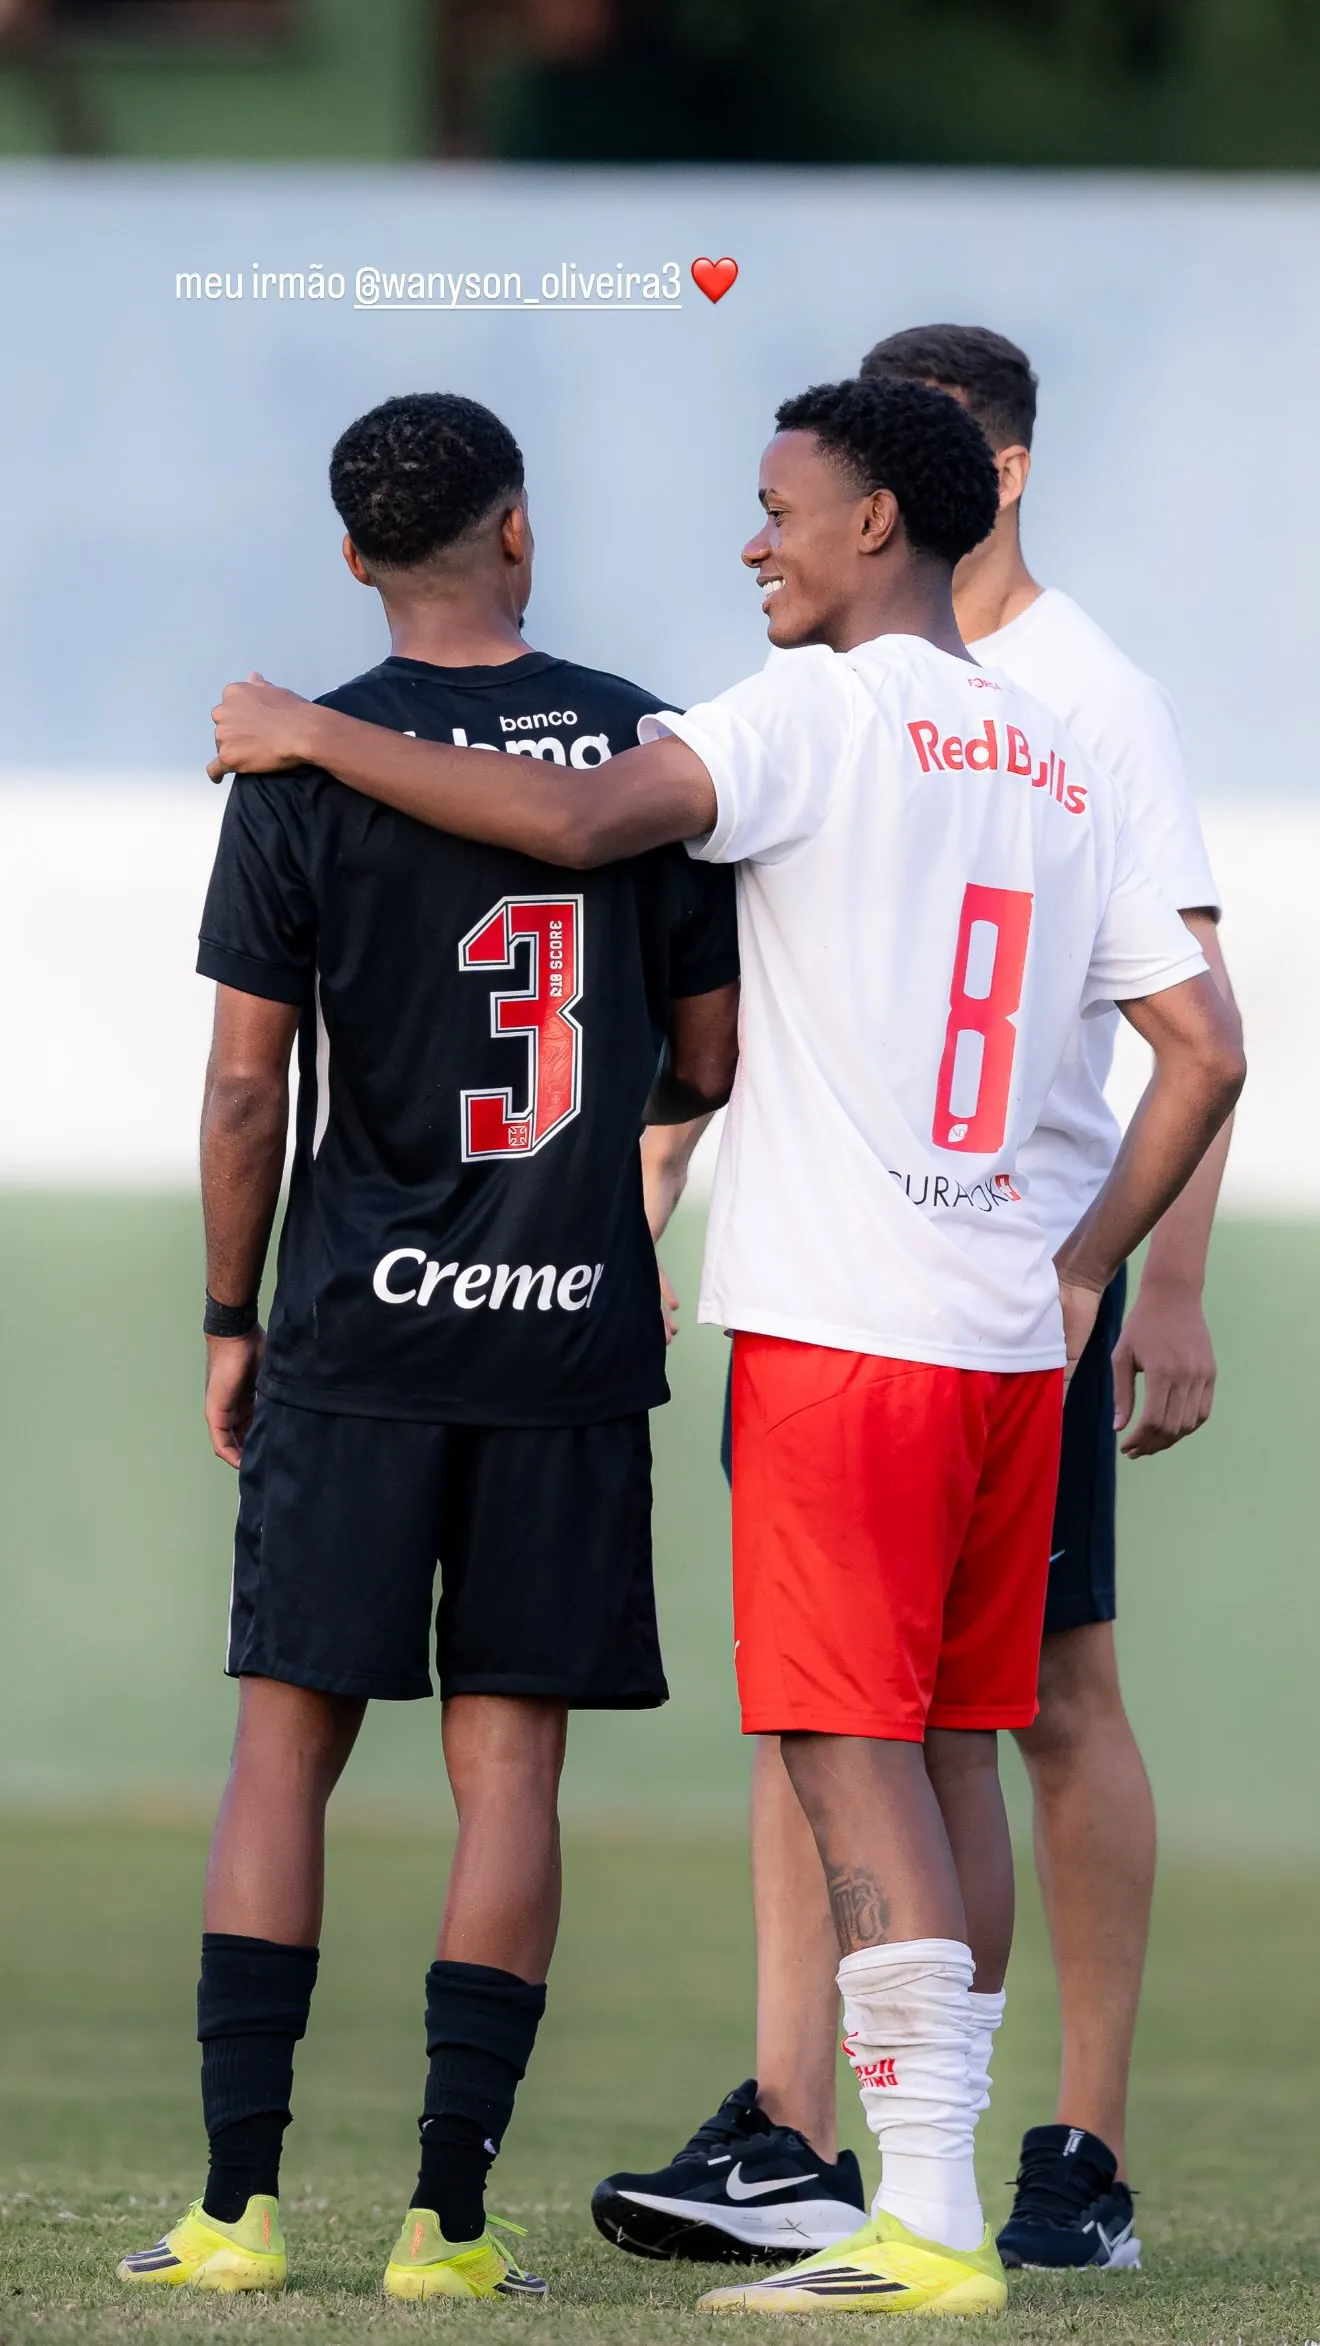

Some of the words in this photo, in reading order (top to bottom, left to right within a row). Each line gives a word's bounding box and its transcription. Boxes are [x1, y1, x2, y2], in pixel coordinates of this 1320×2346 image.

[500, 710, 578, 732] banco
[907, 719, 998, 773] Red
[1006, 723, 1089, 815] Bulls
[549, 920, 563, 970] SCORE
[458, 893, 584, 1163] 3
[932, 881, 1034, 1154] 8
